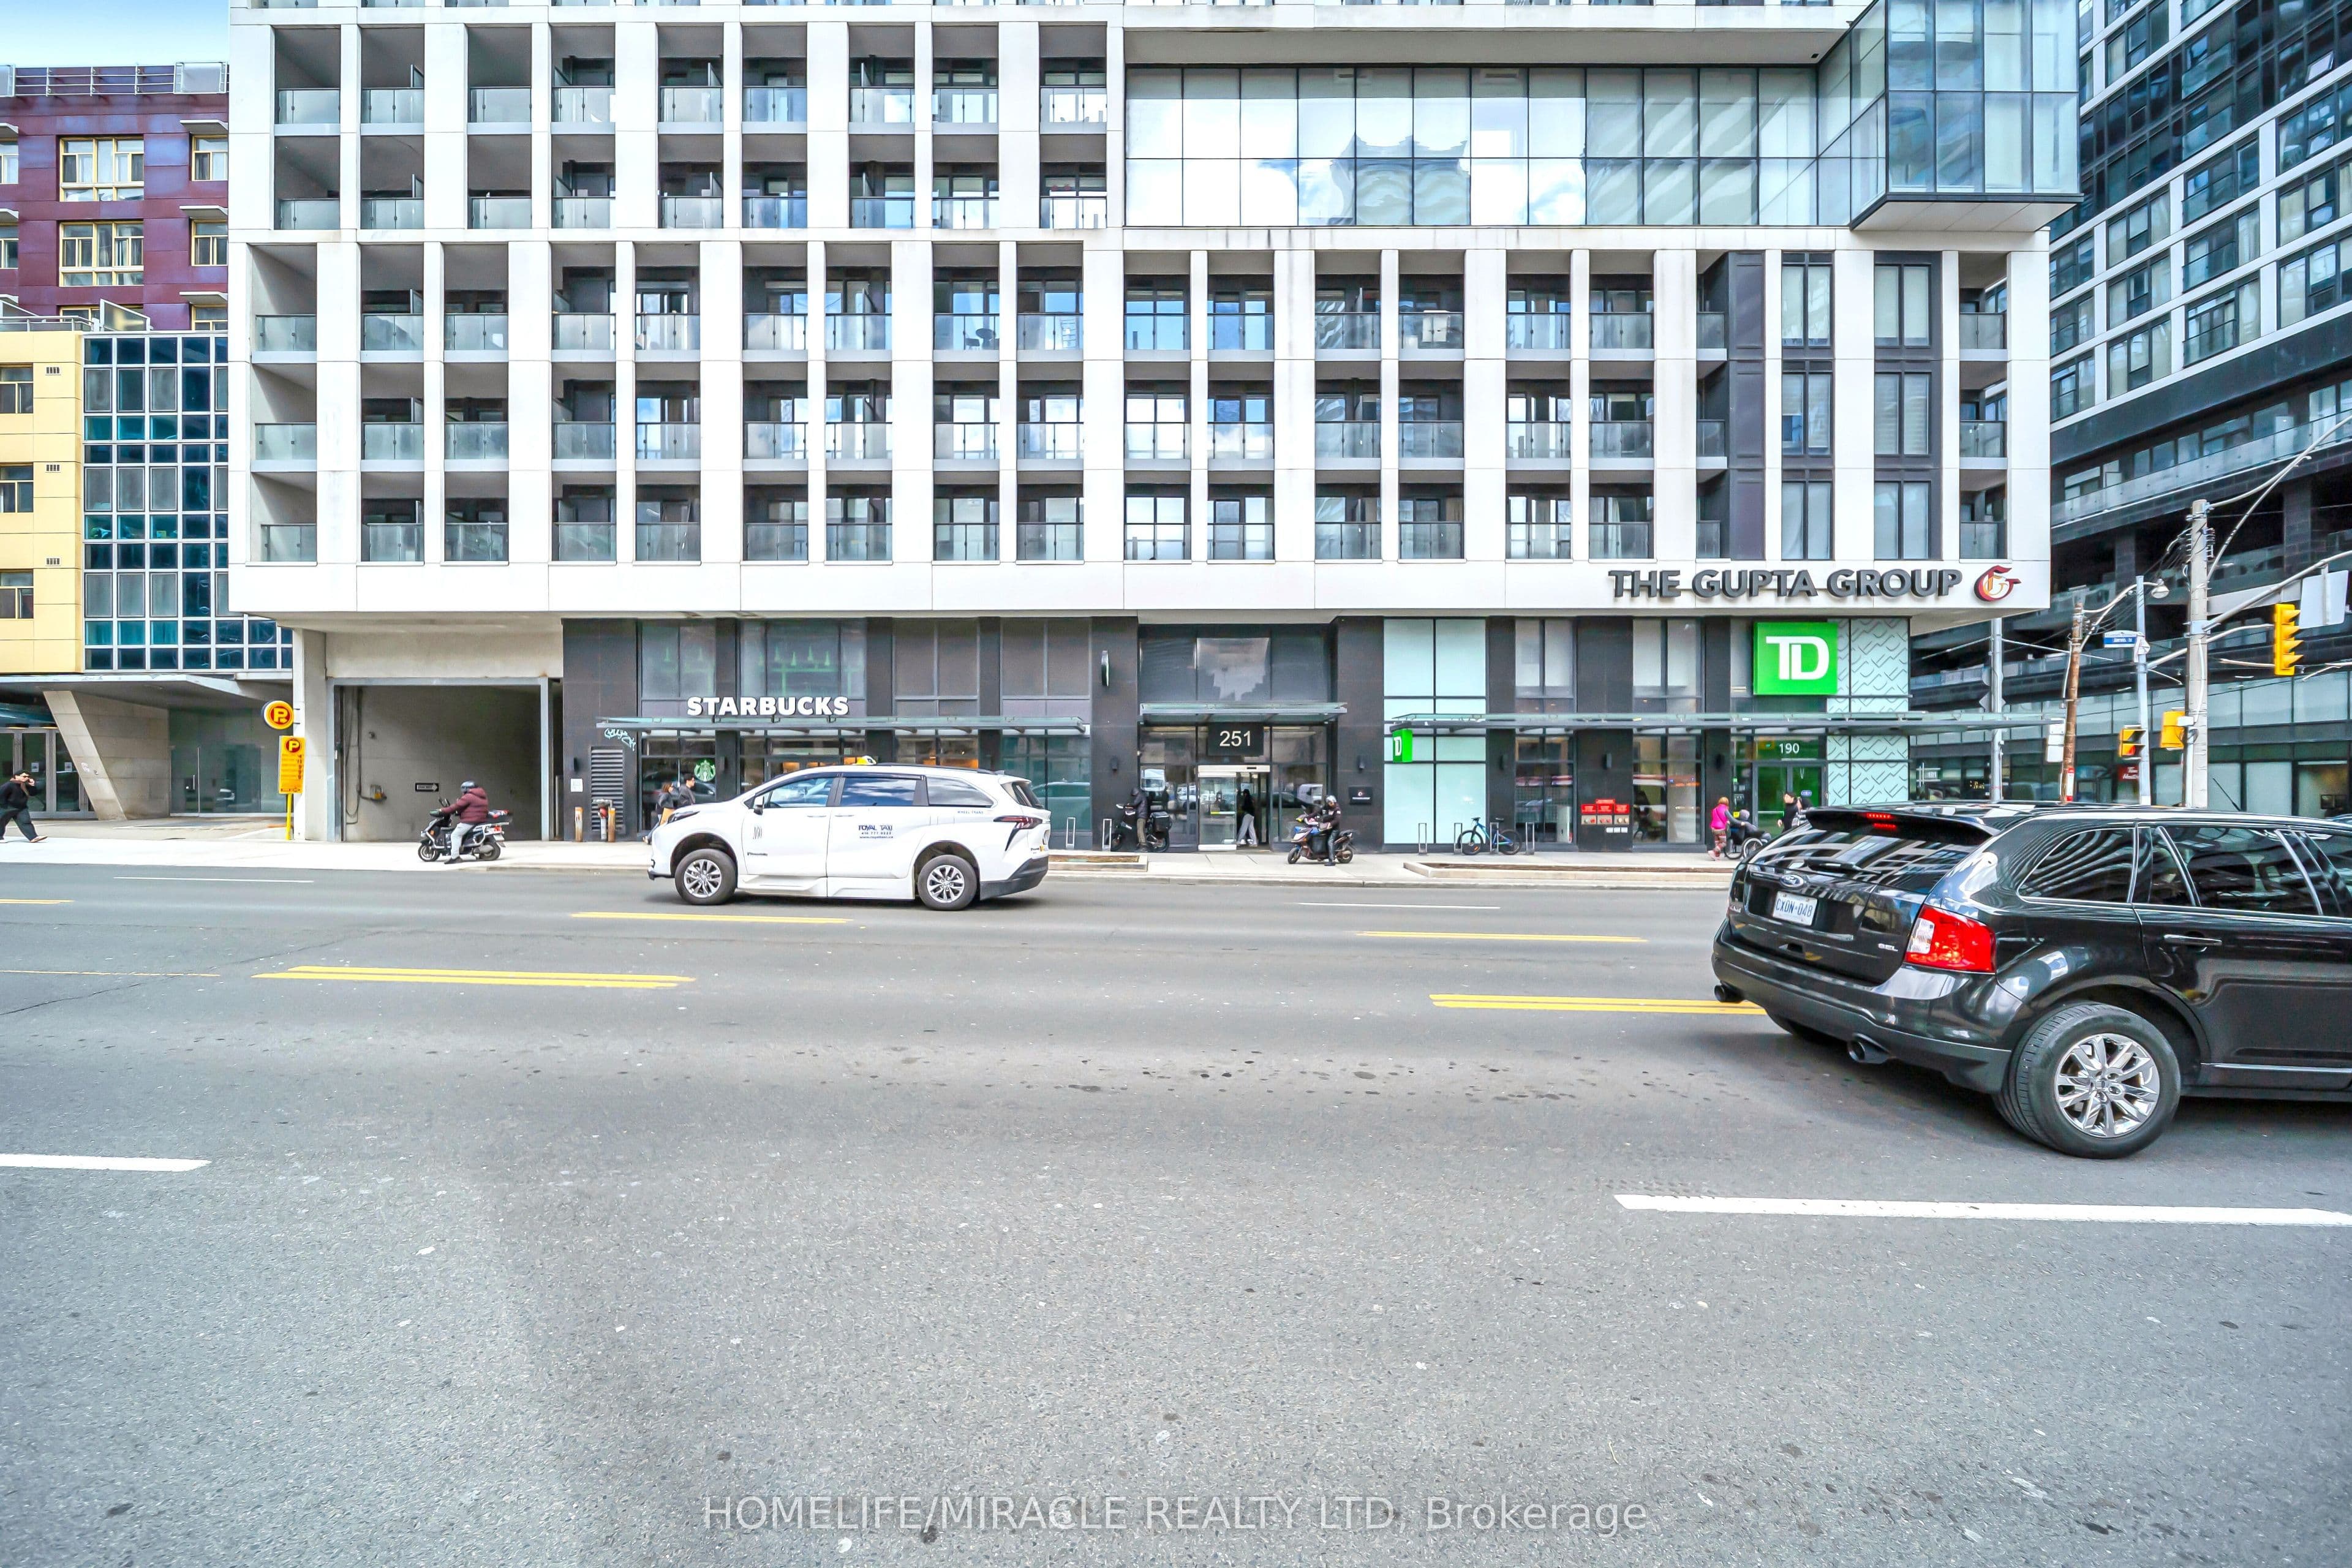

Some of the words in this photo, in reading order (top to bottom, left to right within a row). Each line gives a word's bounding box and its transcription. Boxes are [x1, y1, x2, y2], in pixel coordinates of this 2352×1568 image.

[1608, 570, 1681, 598] THE
[1692, 570, 1819, 598] GUPTA
[1826, 569, 1962, 598] GROUP
[1766, 636, 1830, 680] TD
[687, 696, 849, 716] STARBUCKS
[1219, 730, 1251, 747] 251
[1779, 742, 1800, 755] 190
